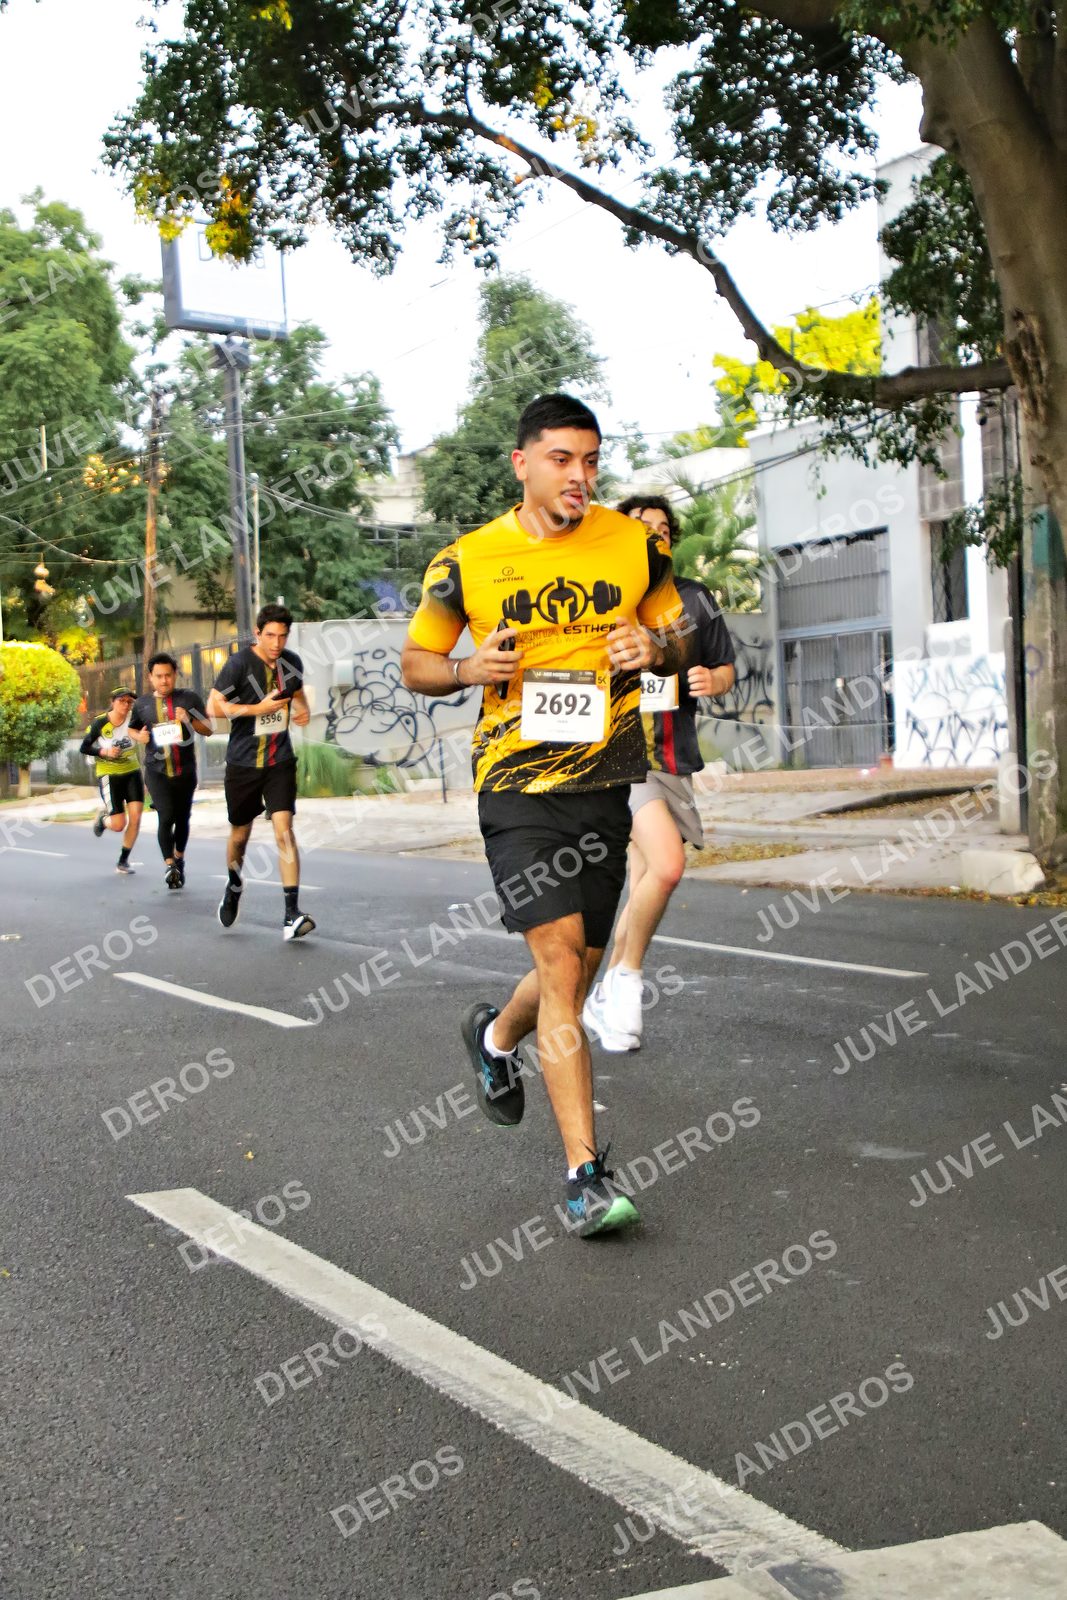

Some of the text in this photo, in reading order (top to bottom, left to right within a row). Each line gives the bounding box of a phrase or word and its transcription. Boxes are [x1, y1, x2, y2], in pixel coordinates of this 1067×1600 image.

[493, 576, 525, 585] TOPTIME
[563, 623, 617, 636] ESTHER
[597, 676, 607, 685] 5K
[534, 691, 592, 716] 2692
[260, 712, 282, 726] 5596
